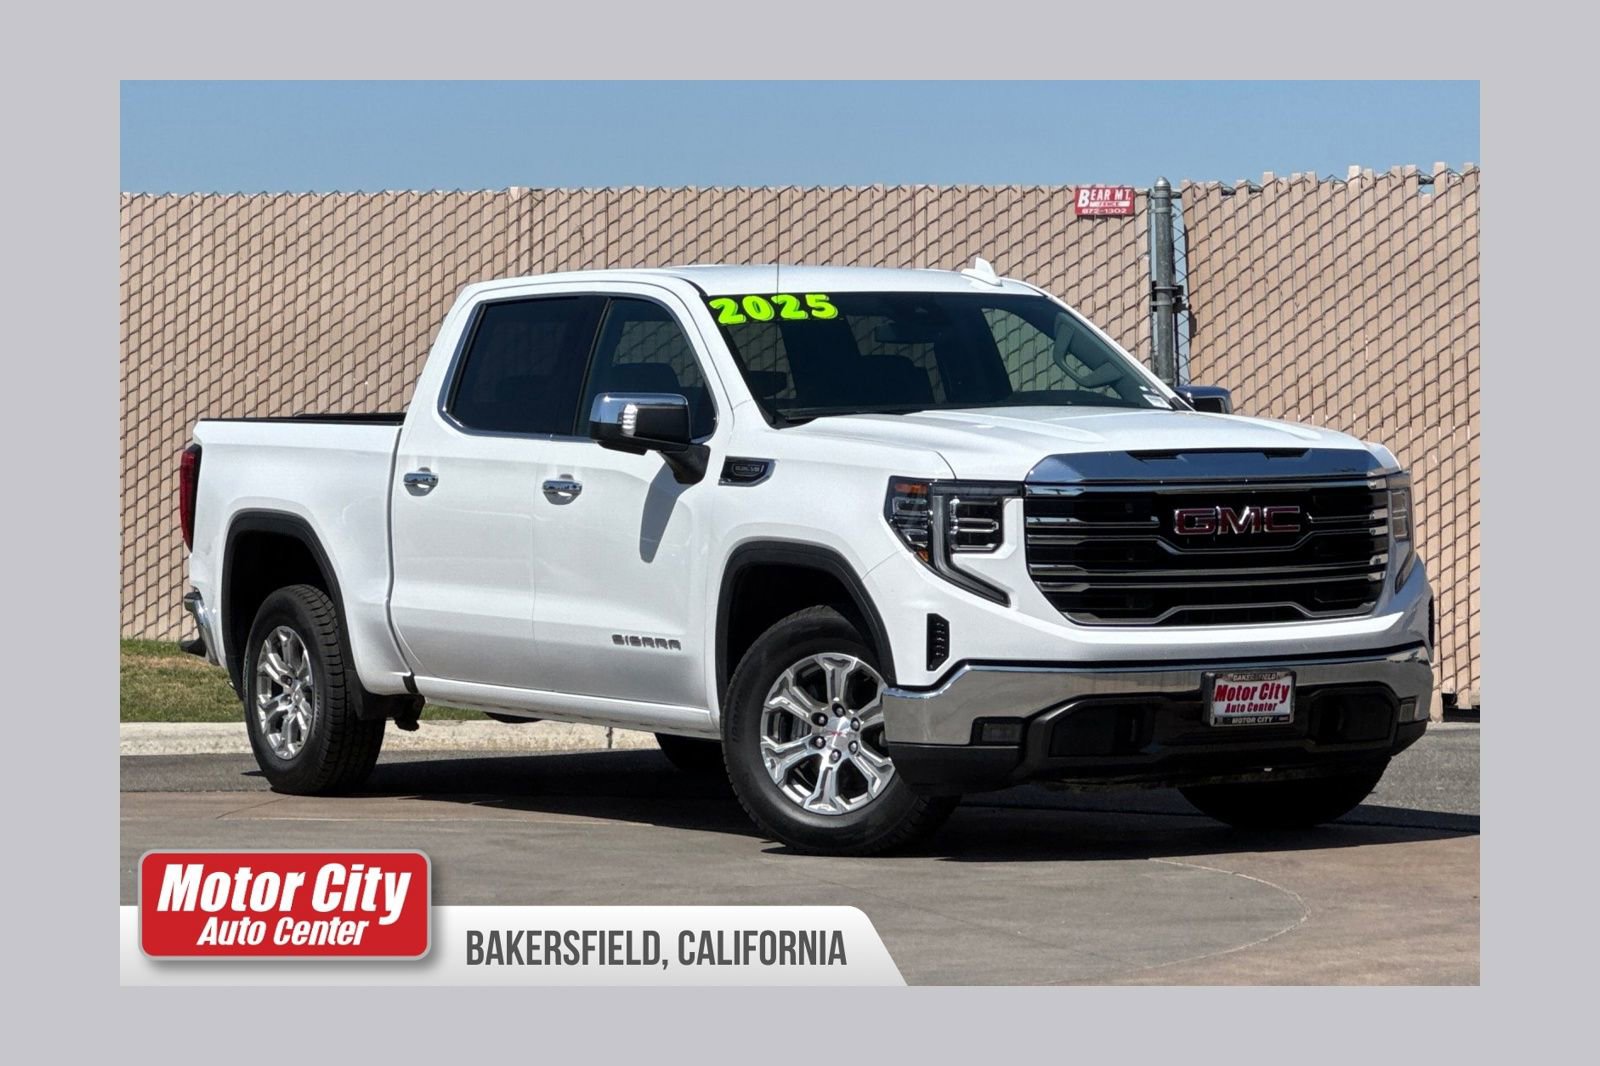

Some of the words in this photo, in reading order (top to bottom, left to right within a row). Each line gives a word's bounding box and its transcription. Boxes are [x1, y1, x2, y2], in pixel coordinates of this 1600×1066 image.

[1078, 188, 1111, 207] BEAR
[709, 294, 838, 324] 2025
[1174, 506, 1300, 535] GMC
[612, 634, 681, 651] SIERRA
[1215, 684, 1257, 702] Motor
[1259, 682, 1290, 704] City
[1225, 703, 1246, 713] Auto
[1247, 702, 1277, 713] Center
